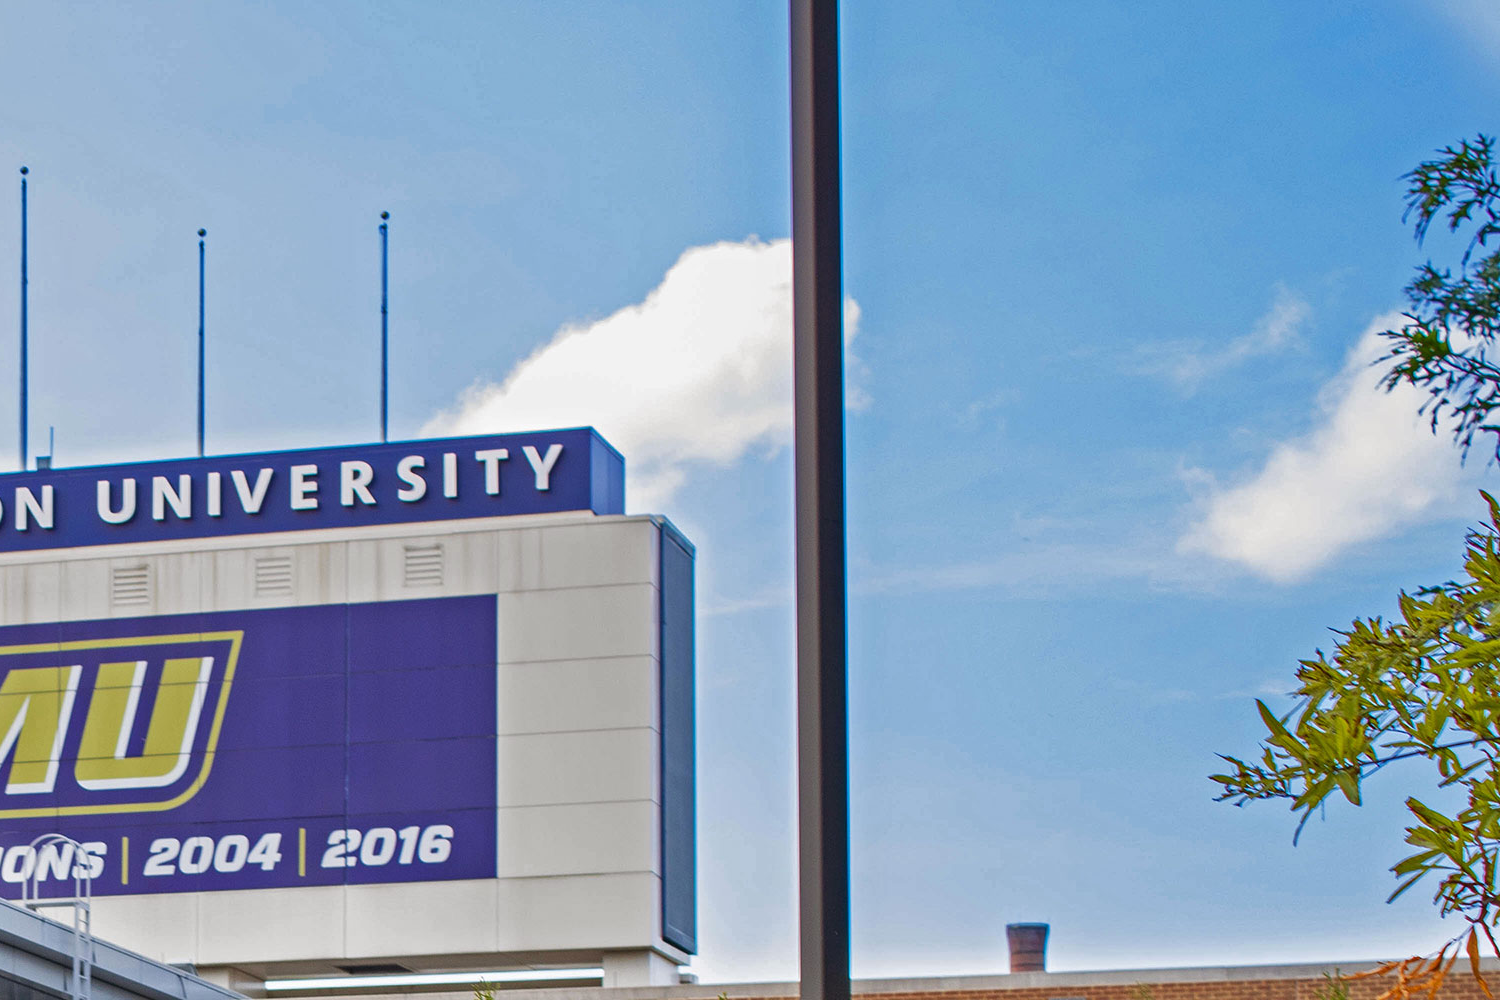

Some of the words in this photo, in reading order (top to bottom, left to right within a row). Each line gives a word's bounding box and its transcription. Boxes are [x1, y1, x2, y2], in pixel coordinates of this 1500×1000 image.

[96, 442, 565, 524] UNIVERSITY
[143, 832, 282, 877] 2004
[320, 824, 454, 868] 2016
